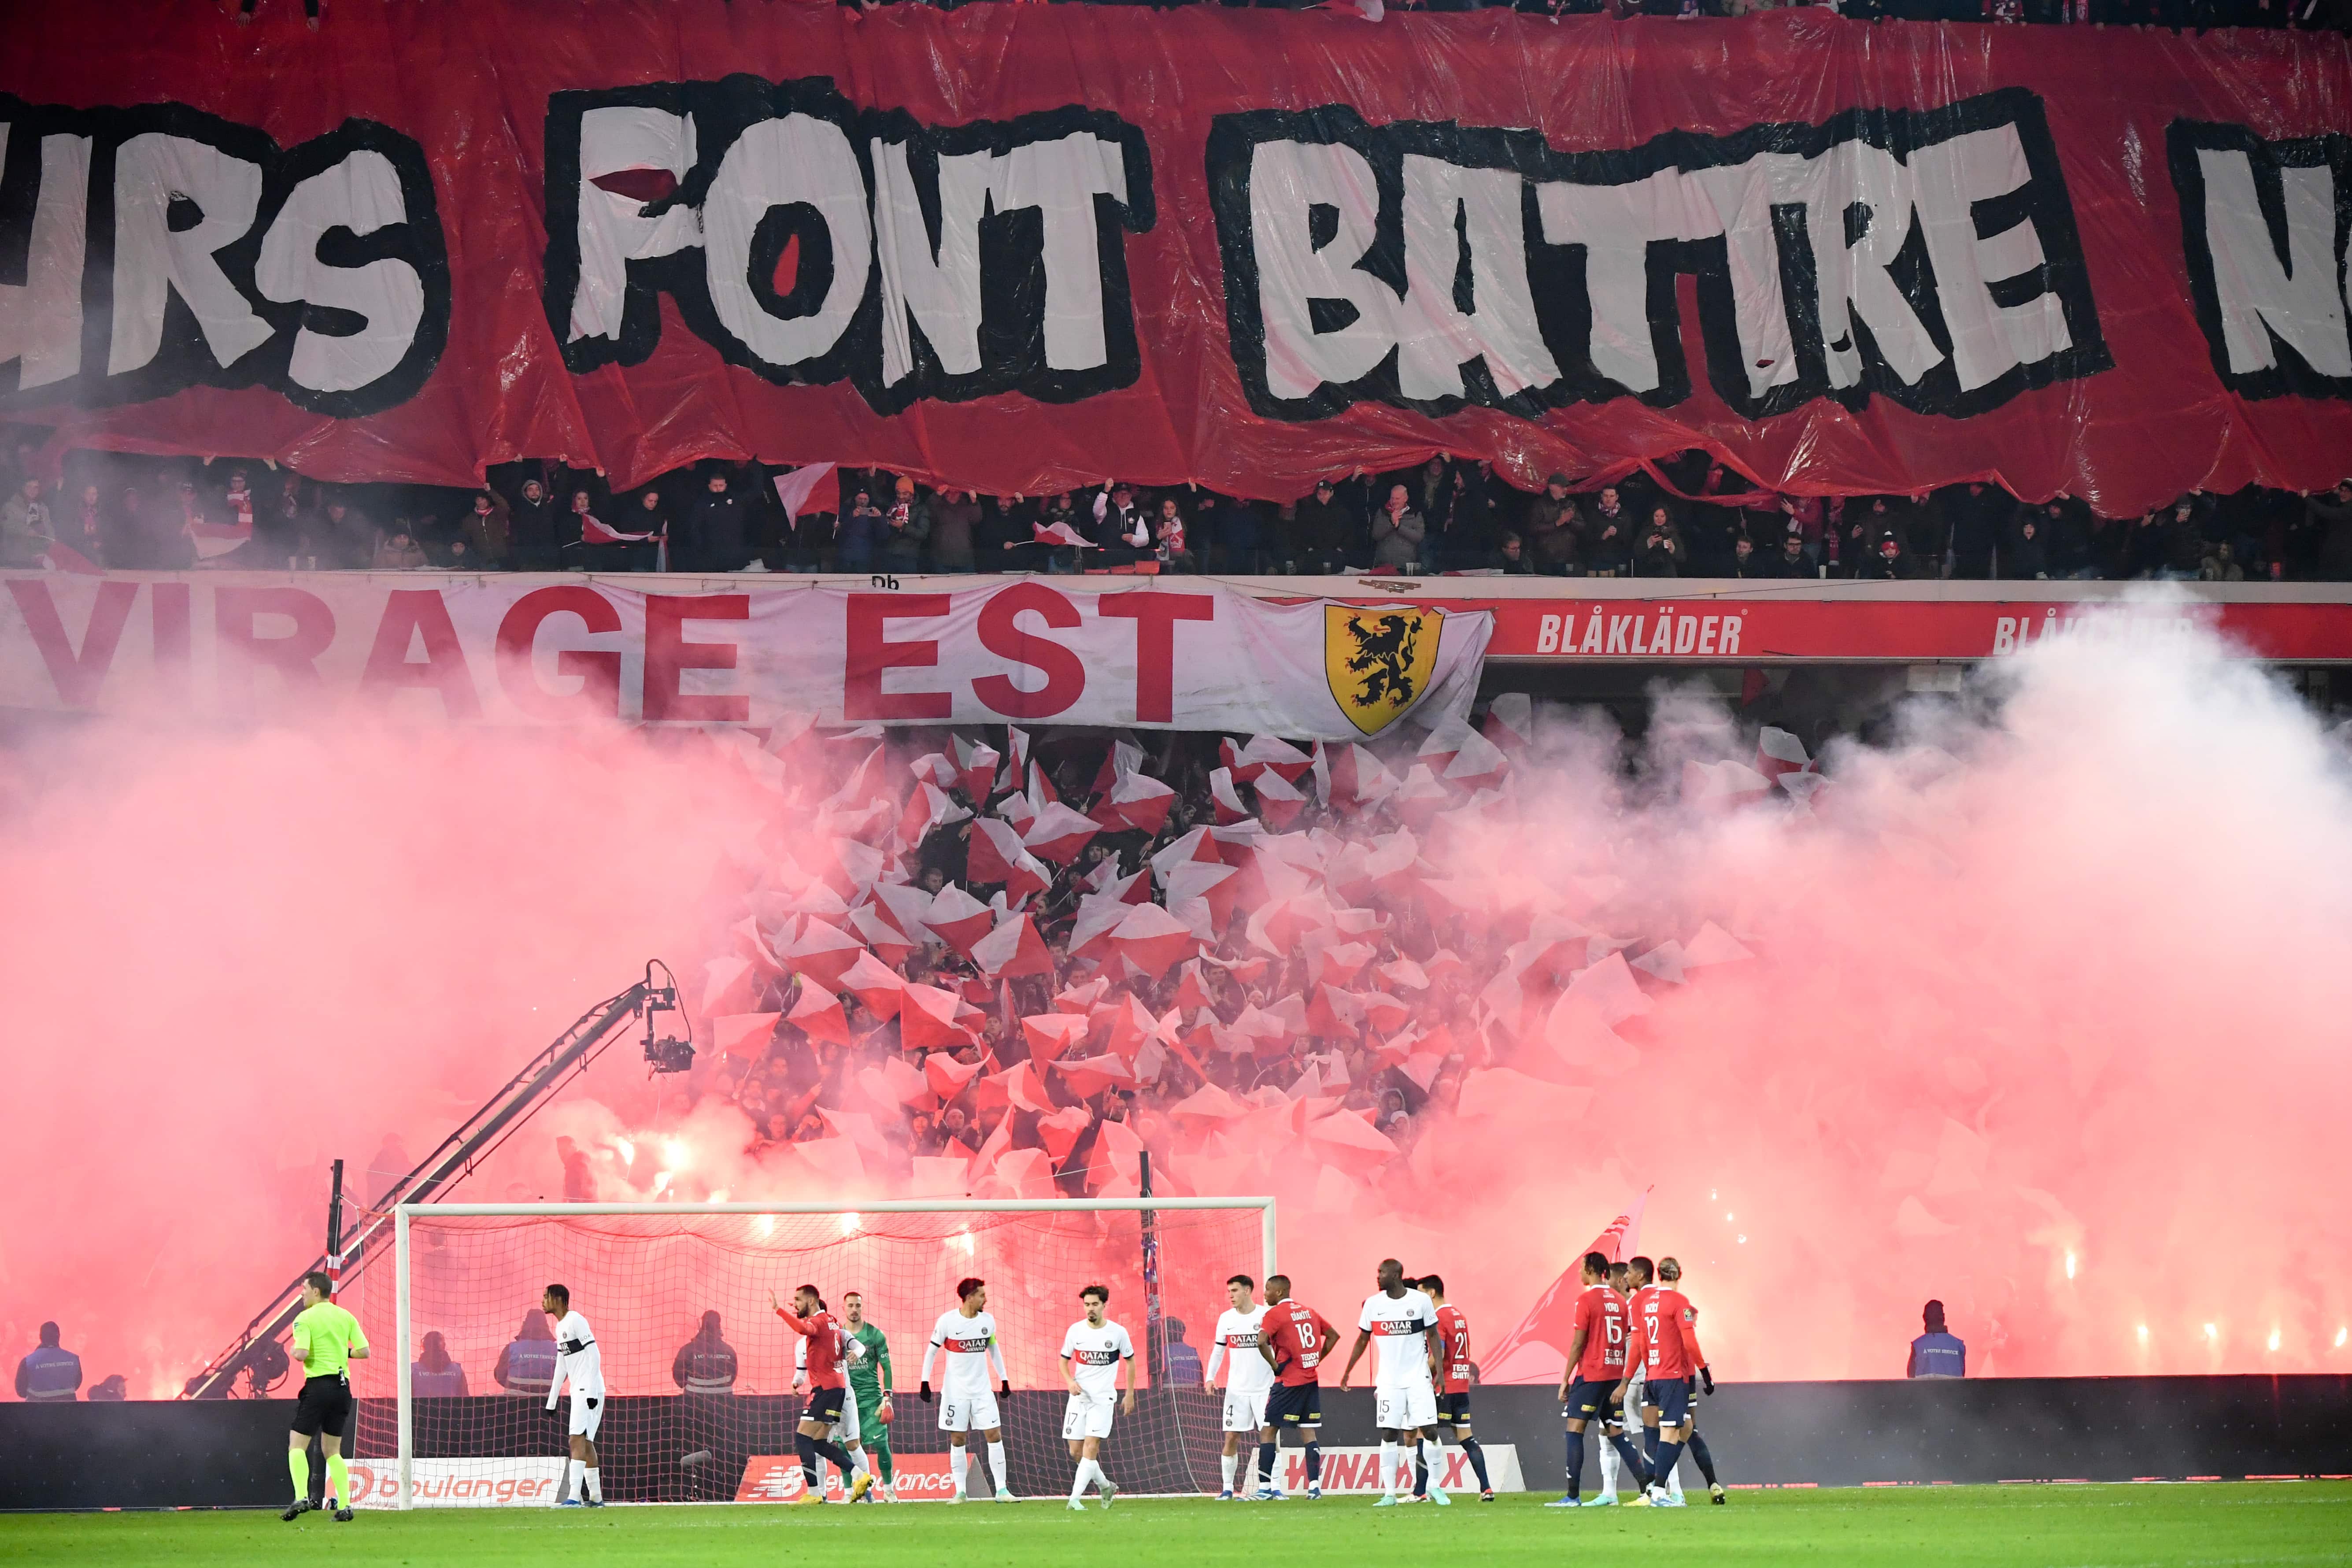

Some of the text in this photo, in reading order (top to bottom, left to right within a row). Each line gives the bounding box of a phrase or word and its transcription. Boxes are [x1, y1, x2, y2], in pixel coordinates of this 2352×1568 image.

[567, 106, 1128, 389] FONT
[1250, 121, 2073, 399] BATTRE
[6, 580, 1213, 723] VIRAGE EST
[1380, 1321, 1412, 1331] QATAR
[1605, 1316, 1622, 1344] 15
[1644, 1316, 1659, 1344] 12
[1230, 1335, 1258, 1344] QATAR
[1295, 1323, 1316, 1349] 18
[958, 1339, 986, 1349] QATAR
[1455, 1332, 1468, 1359] 21
[1080, 1351, 1109, 1361] QATAR
[1301, 1351, 1319, 1361] TEDDY
[947, 1405, 955, 1417] 5
[1226, 1405, 1233, 1417] 4
[1379, 1400, 1390, 1413] 15
[1067, 1412, 1078, 1425] 17
[1284, 1453, 1469, 1490] WINAMX
[379, 1474, 551, 1502] bulanger
